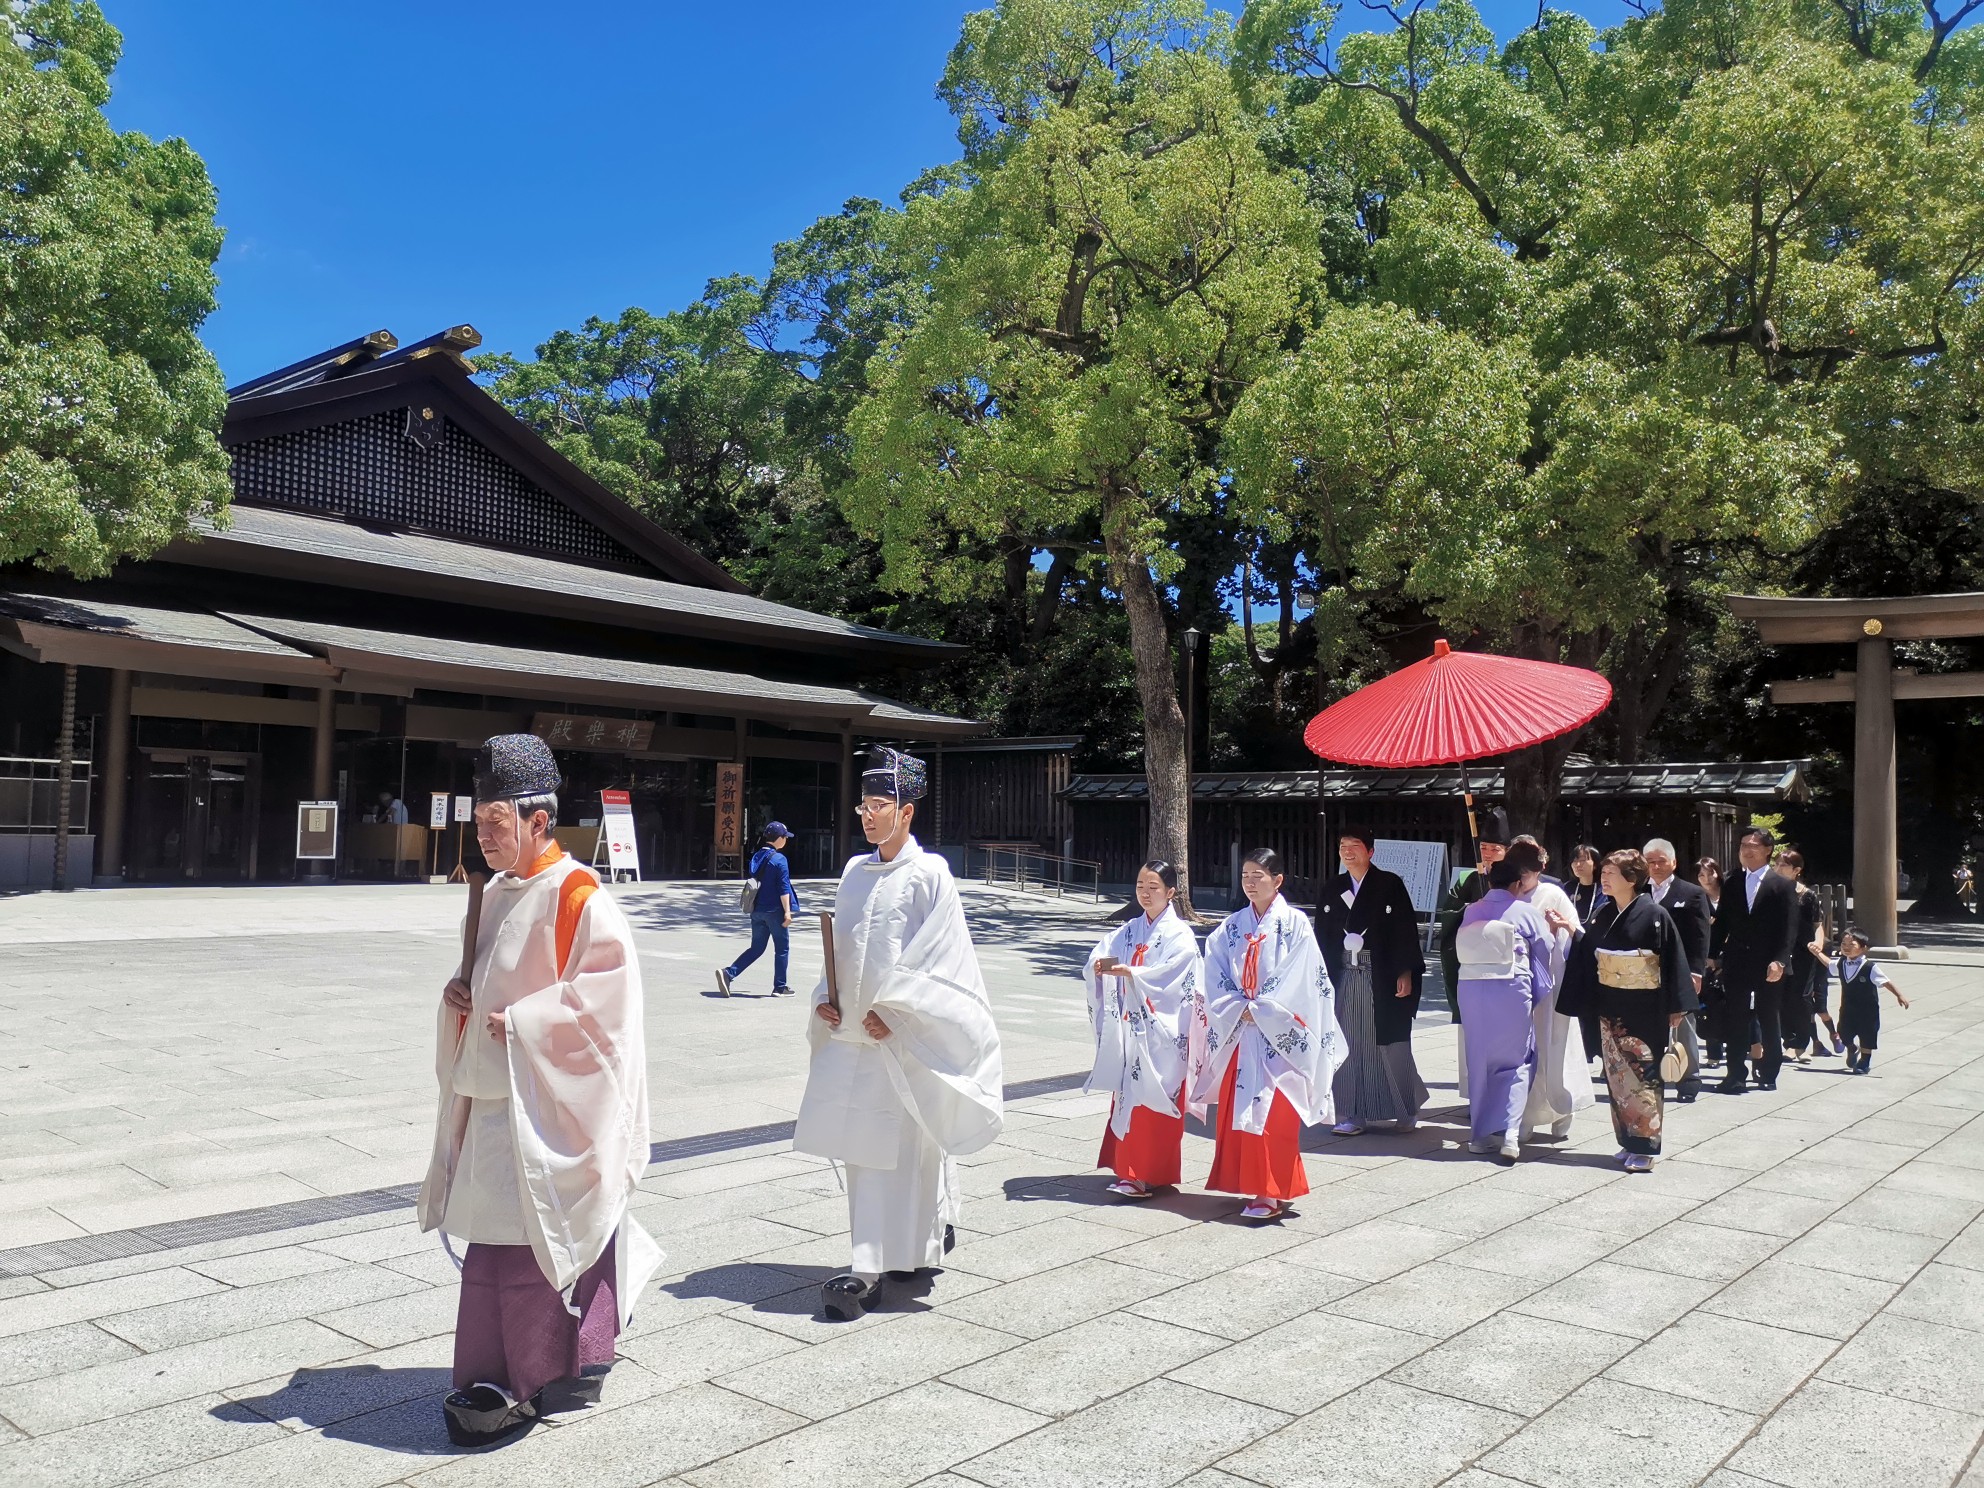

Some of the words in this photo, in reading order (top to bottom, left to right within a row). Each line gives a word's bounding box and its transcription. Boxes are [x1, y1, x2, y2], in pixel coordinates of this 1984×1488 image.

[721, 770, 737, 847] 御祈願受付
